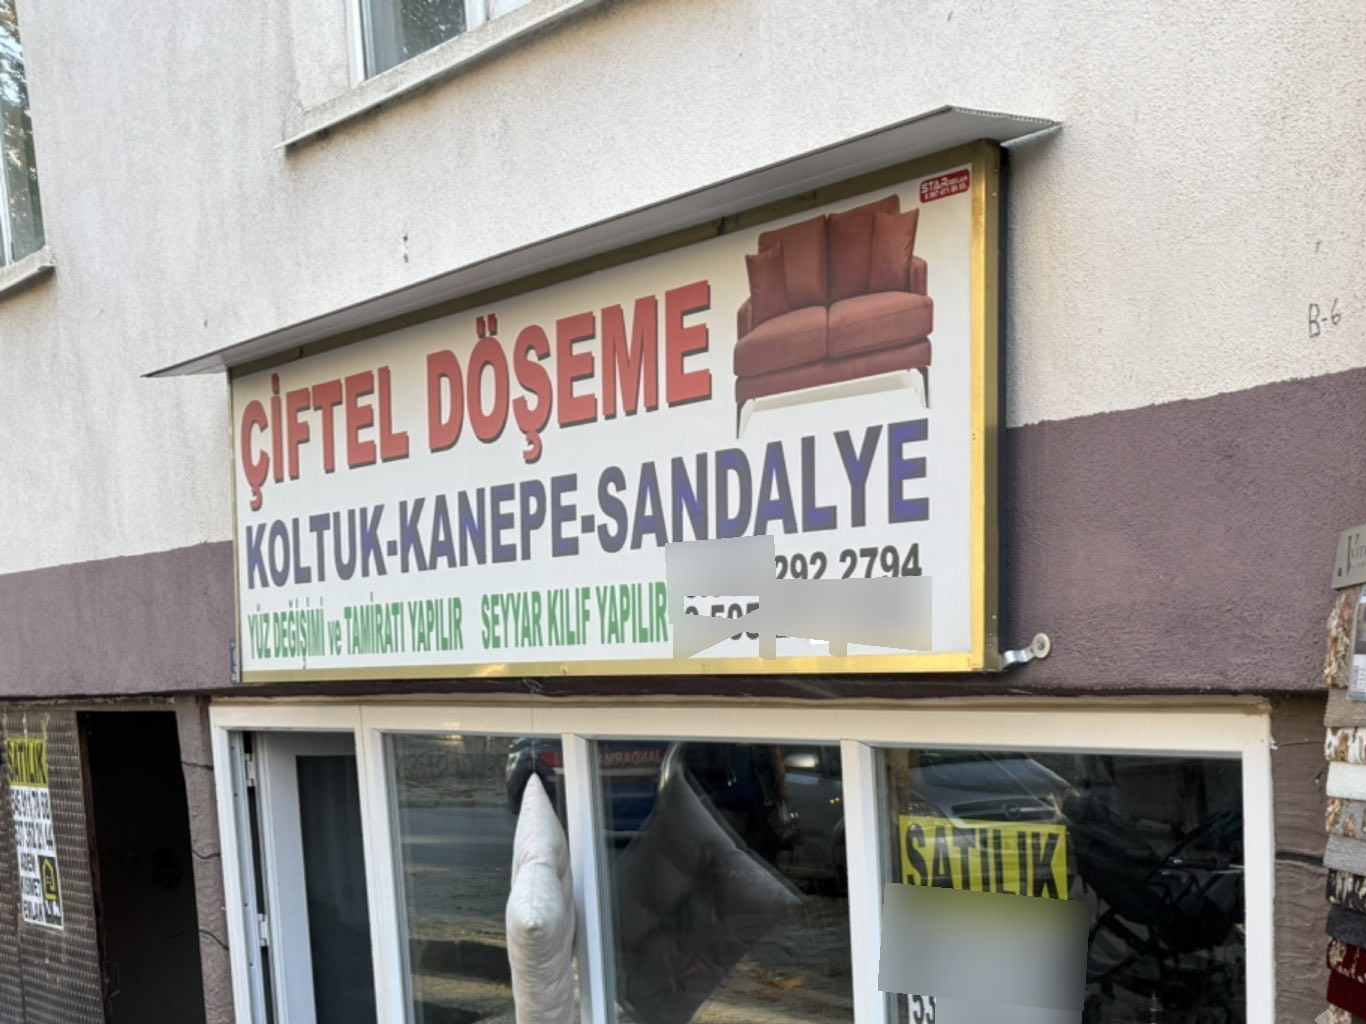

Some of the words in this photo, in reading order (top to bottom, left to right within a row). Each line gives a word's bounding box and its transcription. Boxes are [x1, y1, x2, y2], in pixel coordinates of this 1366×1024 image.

[241, 366, 410, 511] ÇİFTEL
[426, 280, 712, 464] DÖŞEME
[246, 418, 929, 589] KOLTUK-KANEPE-SANDALYE
[838, 543, 923, 579] 2794
[247, 604, 271, 659] YÜZ
[327, 619, 342, 656] ve
[344, 592, 405, 655] TAMİRATI
[408, 597, 464, 652] YAPILIR
[481, 591, 543, 649] SEYYAR
[547, 587, 590, 646] KILIF
[595, 581, 669, 645] YAPILIR
[905, 822, 1060, 899] SATILIK
